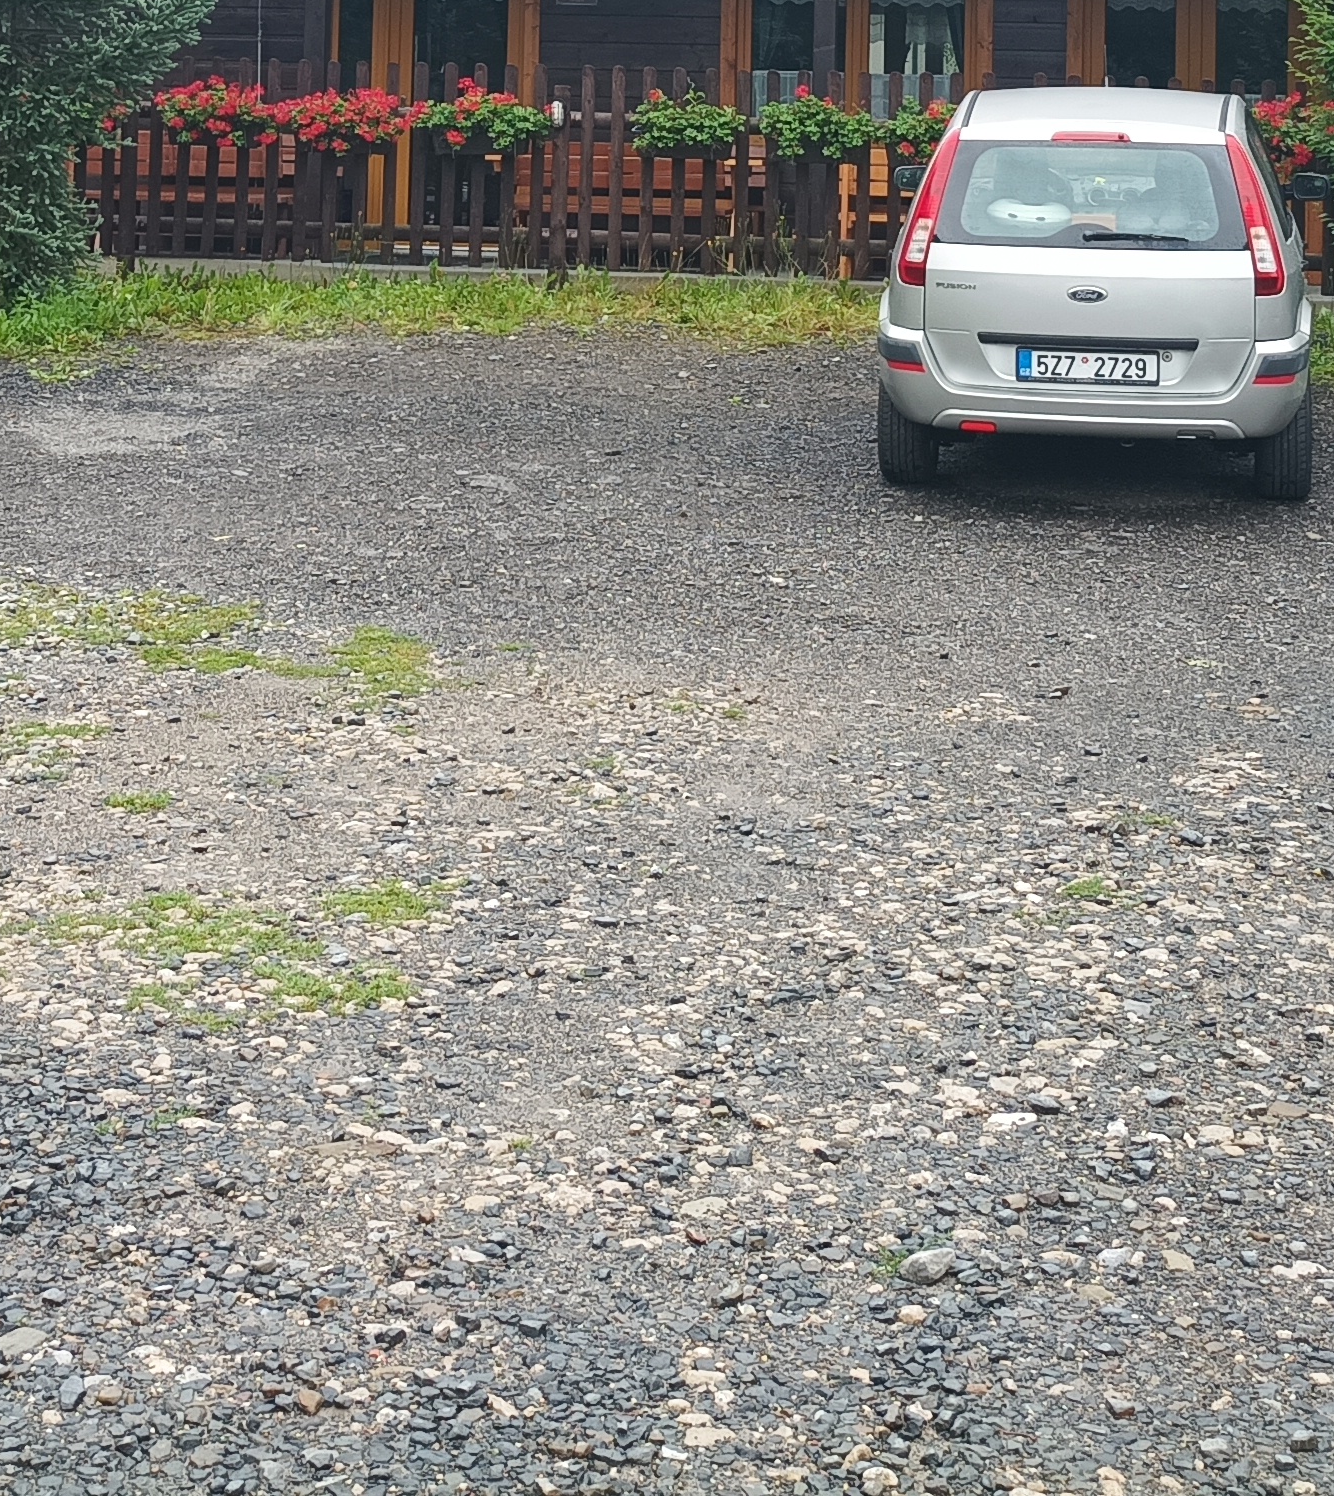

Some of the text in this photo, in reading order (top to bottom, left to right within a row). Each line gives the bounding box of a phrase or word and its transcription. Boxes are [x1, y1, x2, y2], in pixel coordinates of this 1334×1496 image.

[935, 282, 977, 290] FUSION
[1037, 354, 1147, 379] 5Z7 2729
[1019, 368, 1031, 376] CZ
